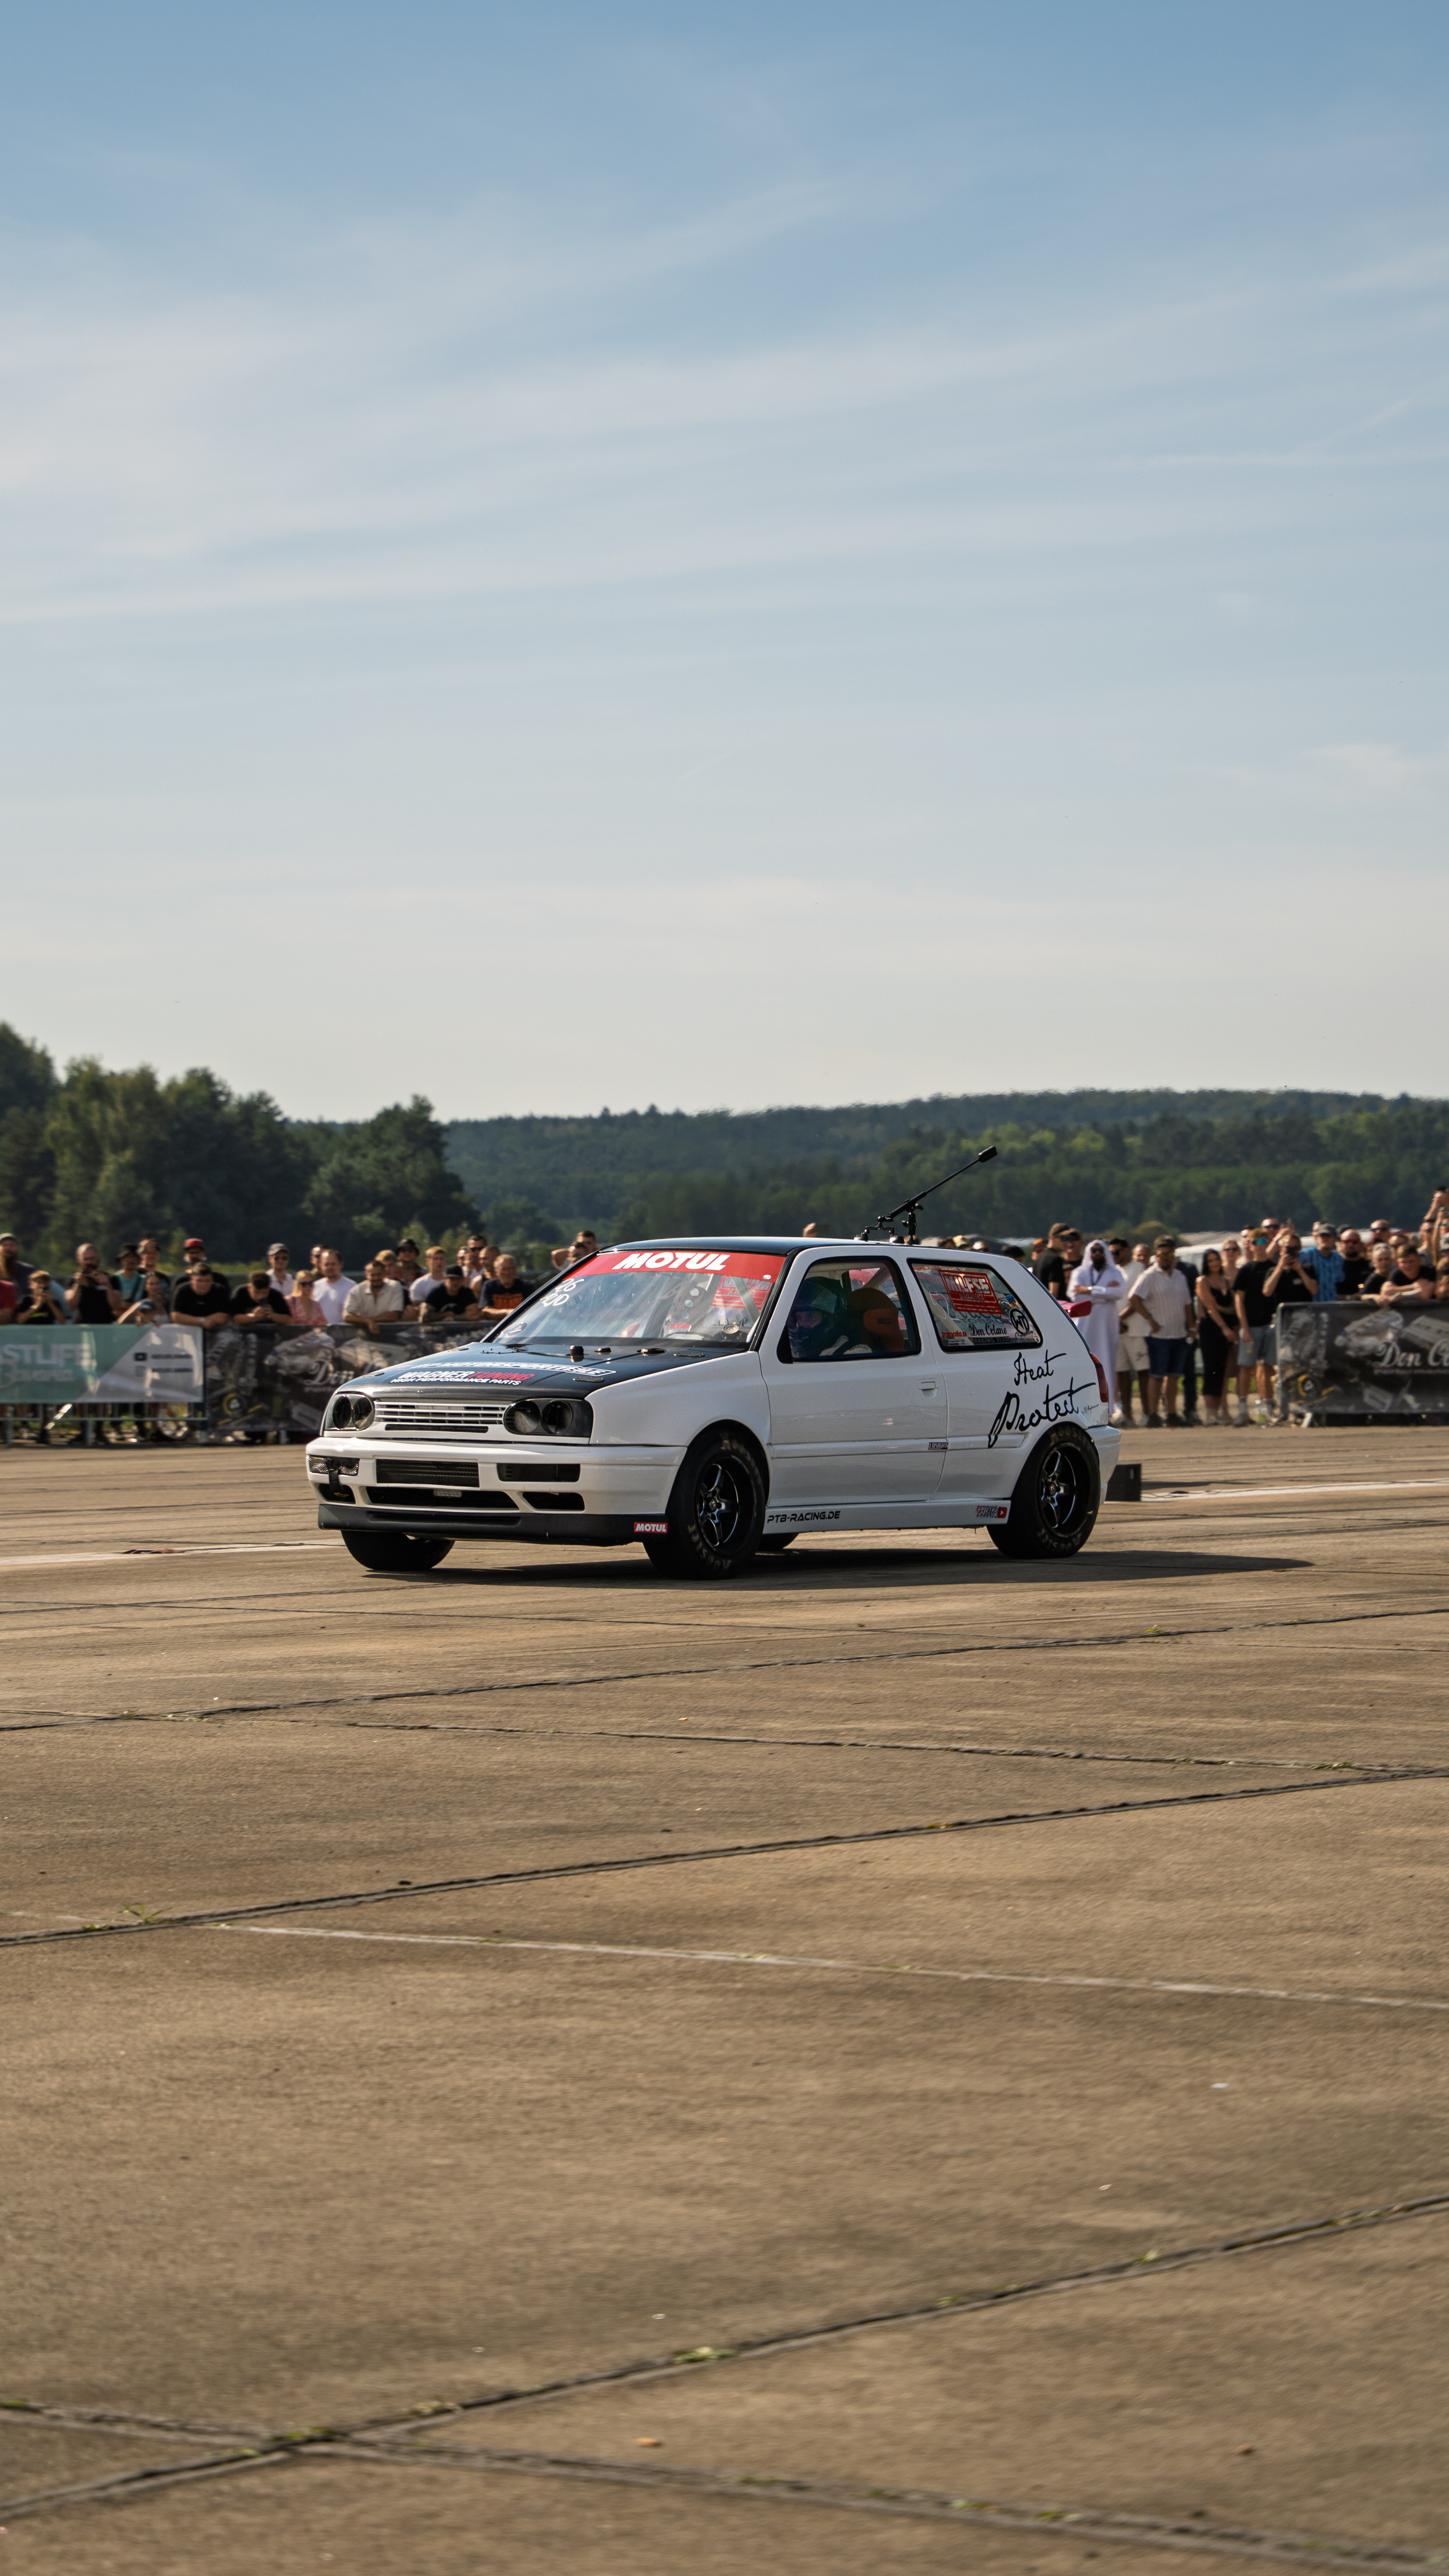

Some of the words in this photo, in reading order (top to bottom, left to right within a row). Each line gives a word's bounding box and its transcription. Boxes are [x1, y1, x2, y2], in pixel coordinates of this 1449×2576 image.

[612, 1252, 731, 1271] MOTUL
[968, 1323, 985, 1336] Don
[985, 1322, 1007, 1335] Octane
[1013, 1349, 1067, 1386] Heat
[988, 1376, 1096, 1449] Protect
[767, 1511, 841, 1523] PTB-RACING.DE
[636, 1524, 666, 1532] MOTUL
